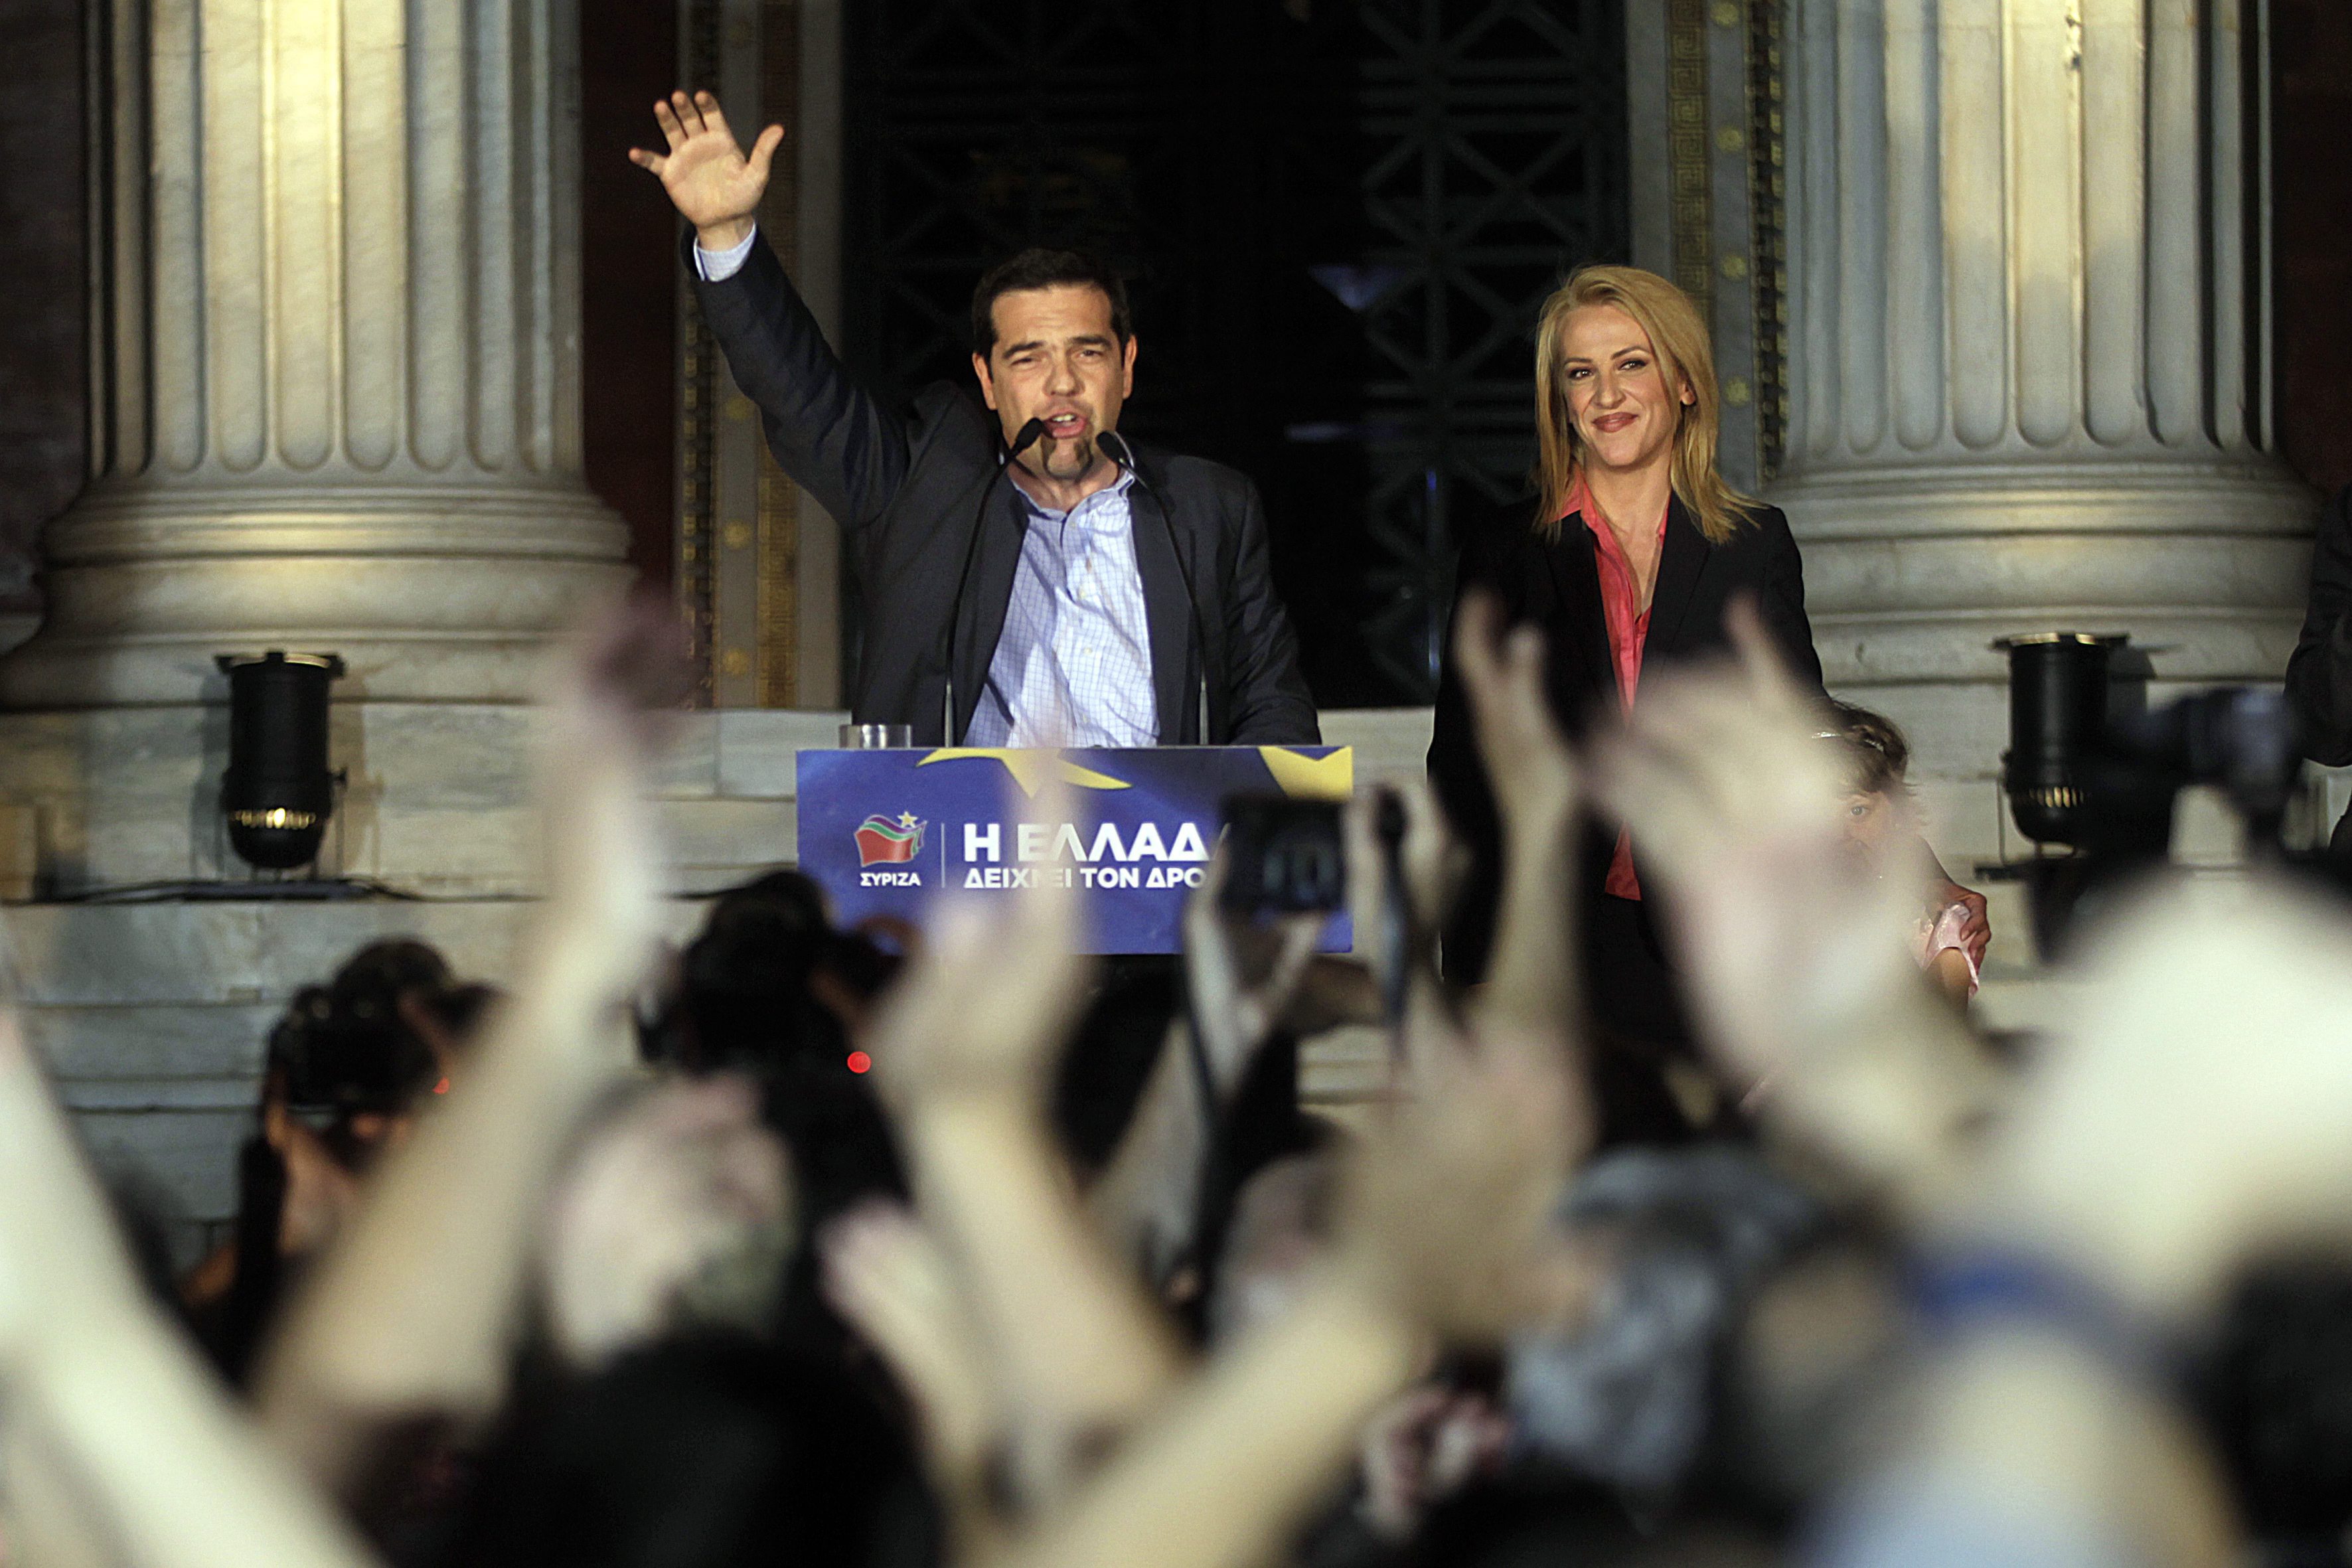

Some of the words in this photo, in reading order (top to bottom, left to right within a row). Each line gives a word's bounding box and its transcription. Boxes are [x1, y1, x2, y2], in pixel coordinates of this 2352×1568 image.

[964, 823, 1000, 862] Η
[1017, 823, 1231, 862] ΕΛΛΑΔ
[860, 872, 921, 886] ΣΥΡΙΖΑ
[1079, 867, 1139, 888] ΤΟΝ
[1145, 867, 1206, 888] ΔΡΟ
